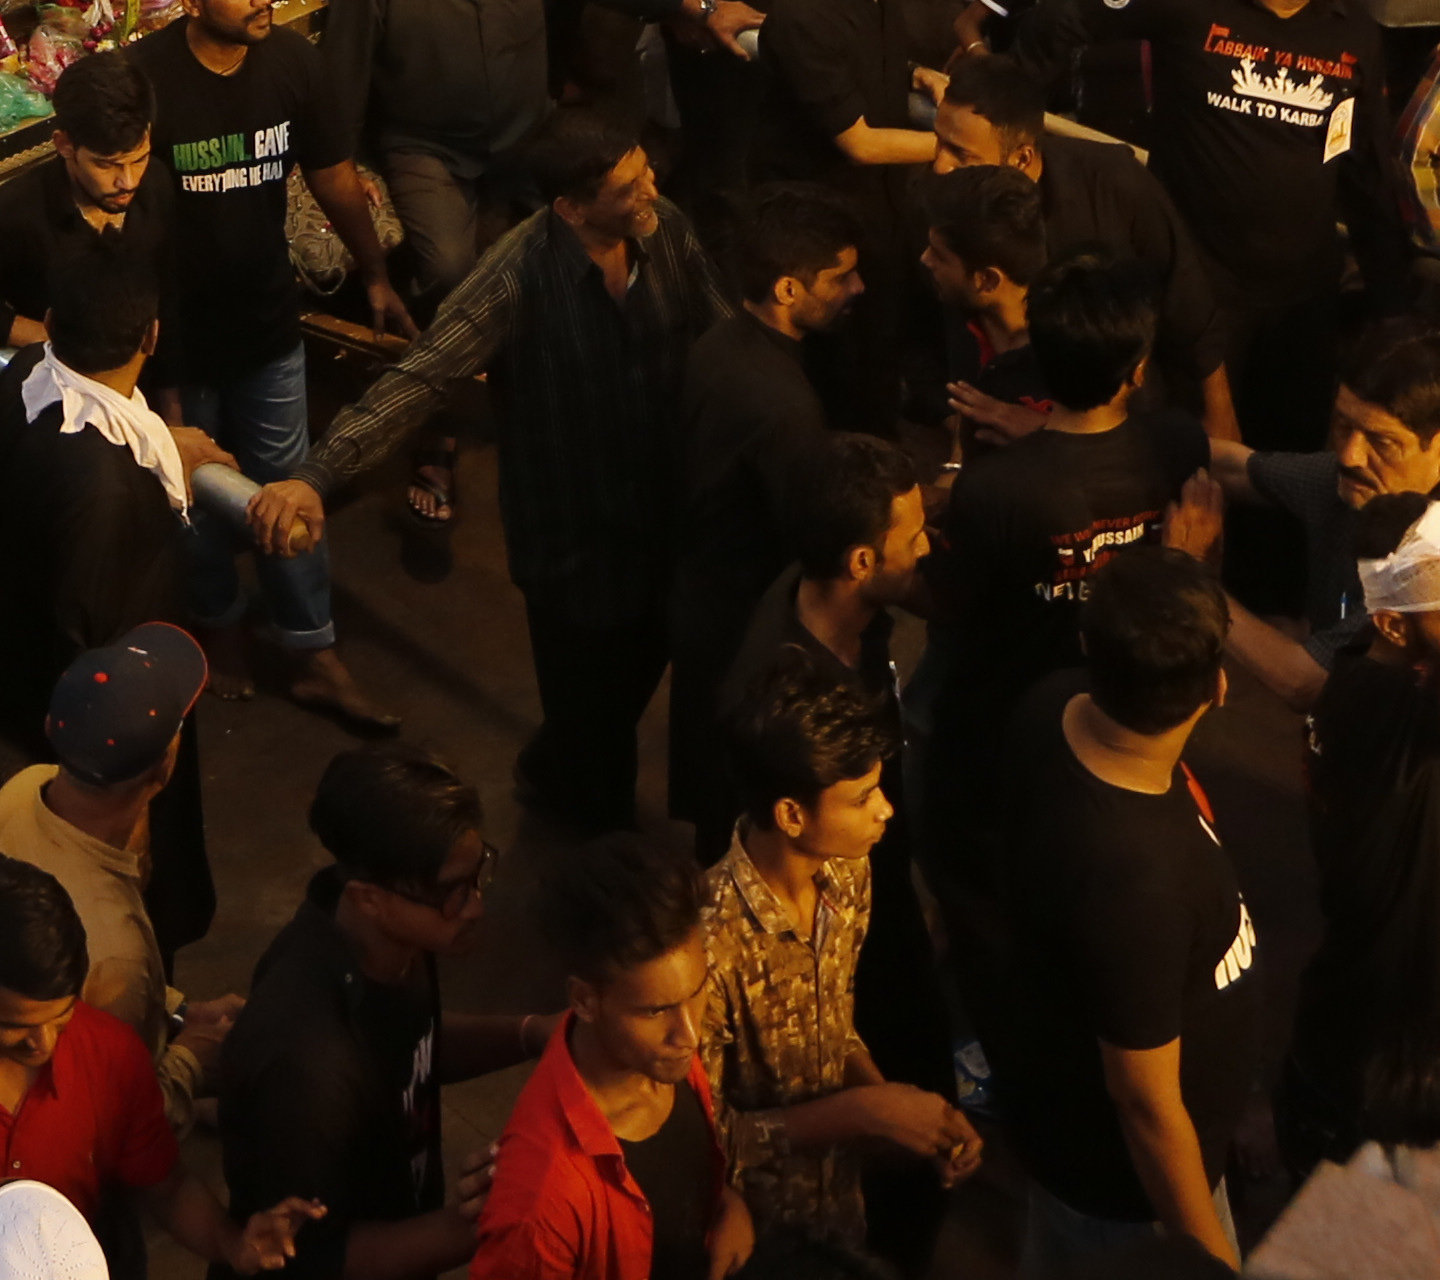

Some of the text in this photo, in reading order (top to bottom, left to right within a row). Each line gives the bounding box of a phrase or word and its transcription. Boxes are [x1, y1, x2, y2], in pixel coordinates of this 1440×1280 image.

[1203, 23, 1270, 62] LABBAIK
[1275, 50, 1293, 67] YA
[1207, 91, 1324, 127] WALK TO KARBA
[254, 121, 290, 159] GAVE
[249, 164, 262, 187] HE
